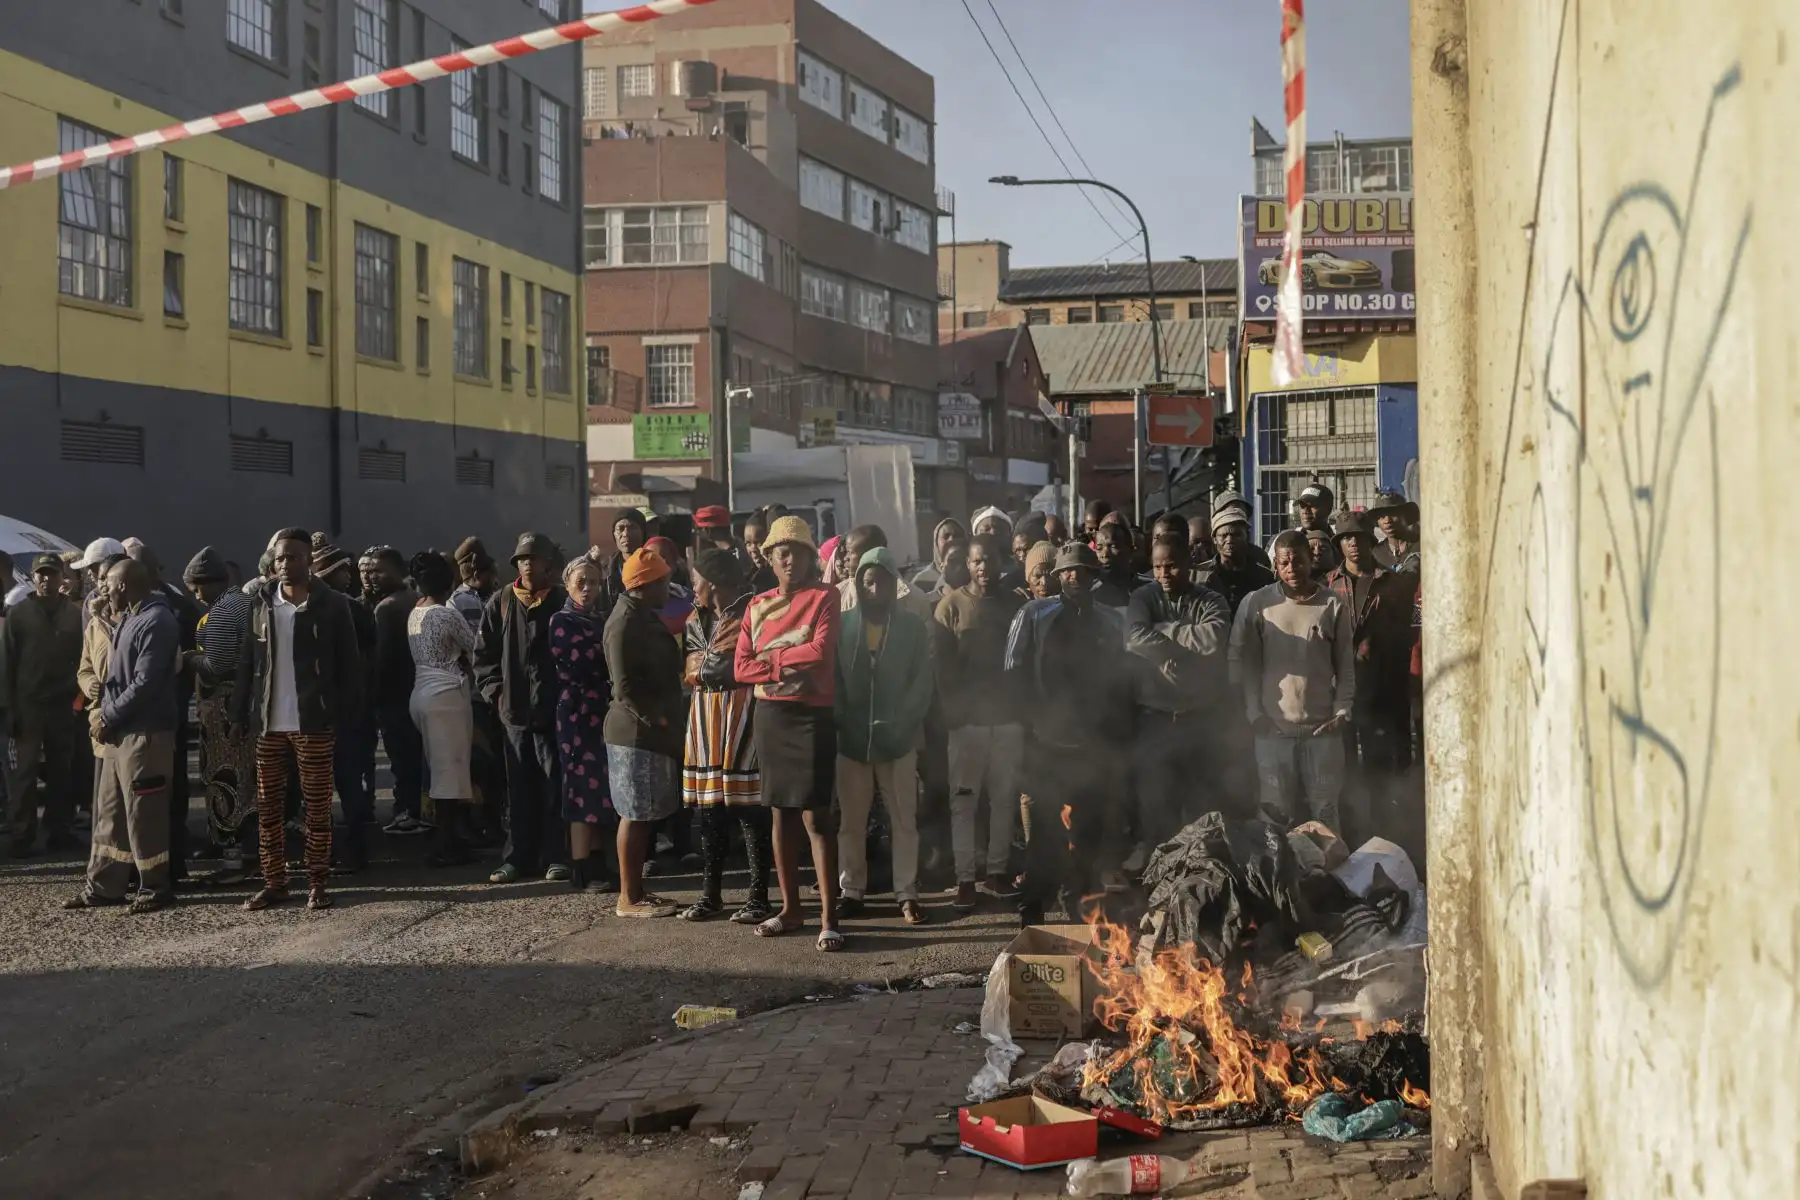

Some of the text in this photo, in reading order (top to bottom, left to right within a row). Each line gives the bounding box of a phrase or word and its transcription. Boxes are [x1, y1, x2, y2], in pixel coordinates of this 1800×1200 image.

[1257, 199, 1415, 234] DOUBL
[1324, 237, 1354, 247] SELLING
[1356, 237, 1366, 246] OF
[1367, 237, 1385, 246] NEW
[1387, 236, 1402, 246] AND
[1334, 293, 1396, 310] NO.30
[940, 415, 979, 428] TO LET
